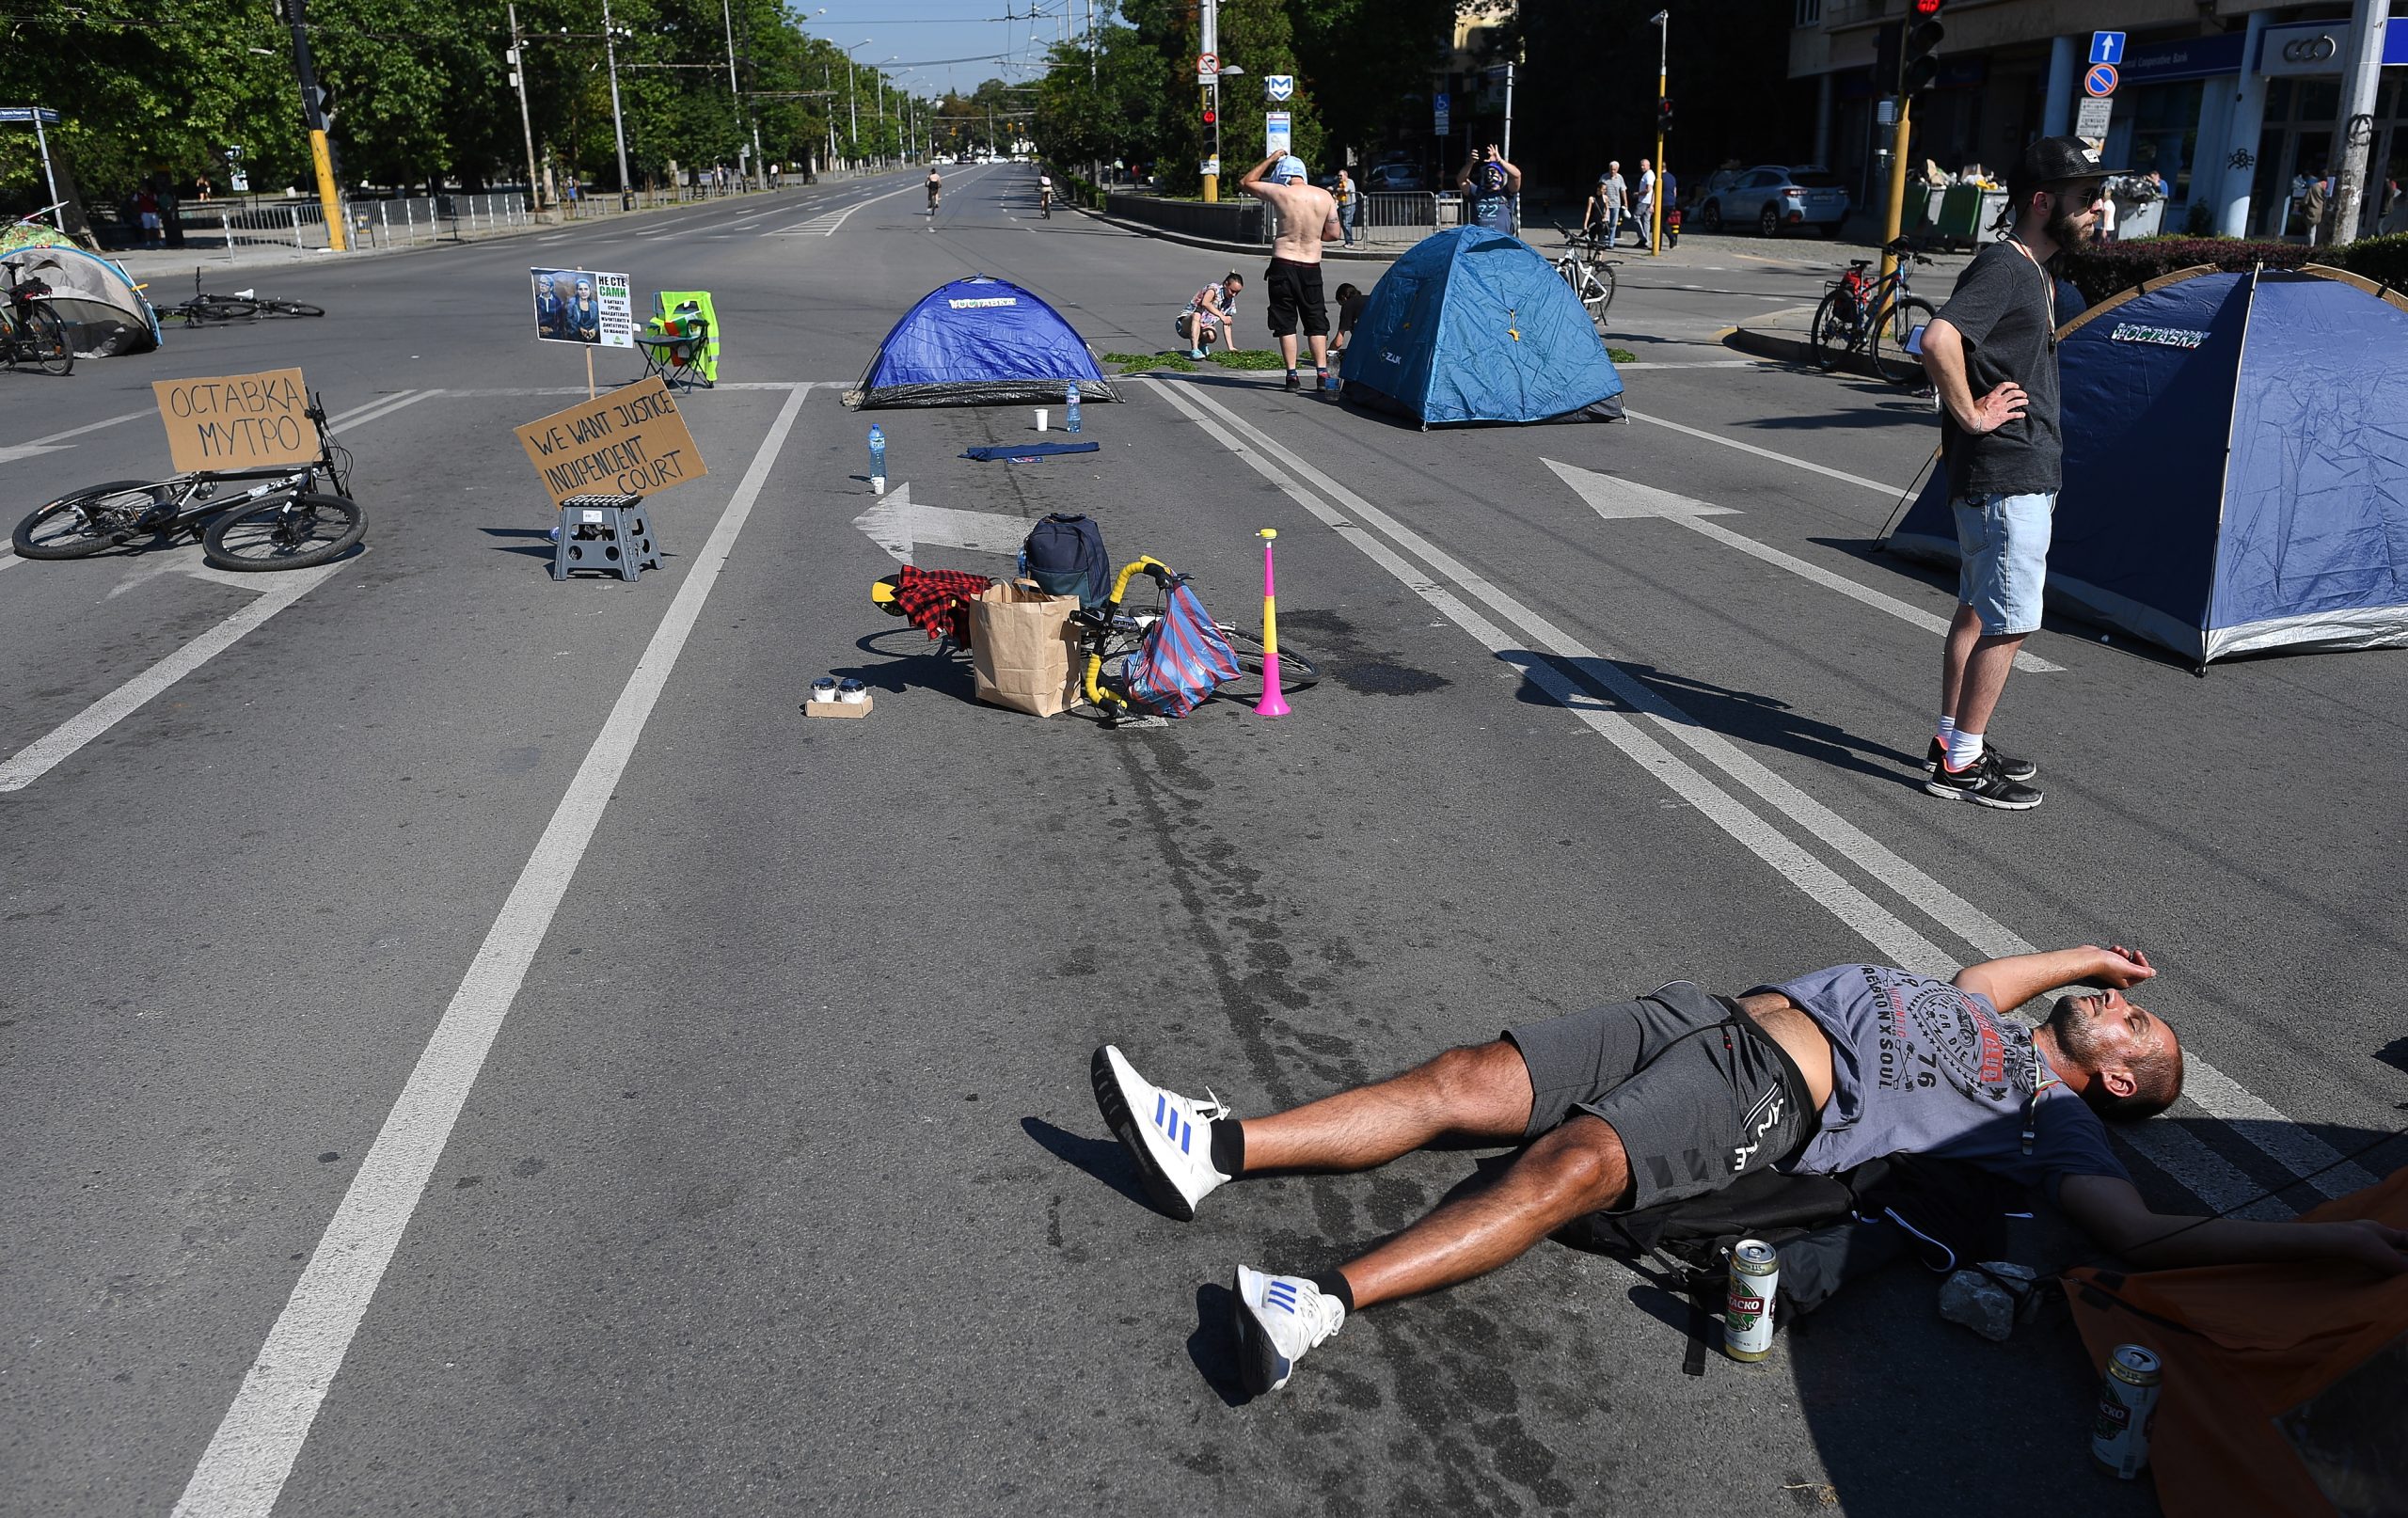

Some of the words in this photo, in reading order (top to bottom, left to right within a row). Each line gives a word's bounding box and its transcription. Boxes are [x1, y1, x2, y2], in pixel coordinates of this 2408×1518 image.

[2172, 52, 2188, 64] Bank
[598, 276, 610, 286] НЕ
[610, 277, 626, 287] СТЕ
[599, 286, 626, 297] САМИ
[171, 377, 307, 418] ОСТАВКА
[198, 415, 300, 456] МУТРО
[530, 427, 568, 456] WE
[566, 411, 612, 445] WANT
[613, 389, 675, 428] JUSTICE
[545, 435, 647, 495] INDIPENDENT
[617, 450, 684, 496] COURT
[1940, 1013, 1952, 1029] OR
[1948, 1036, 1969, 1062] DIE
[1984, 1037, 2001, 1079] CLUB
[1917, 1052, 1937, 1088] 76
